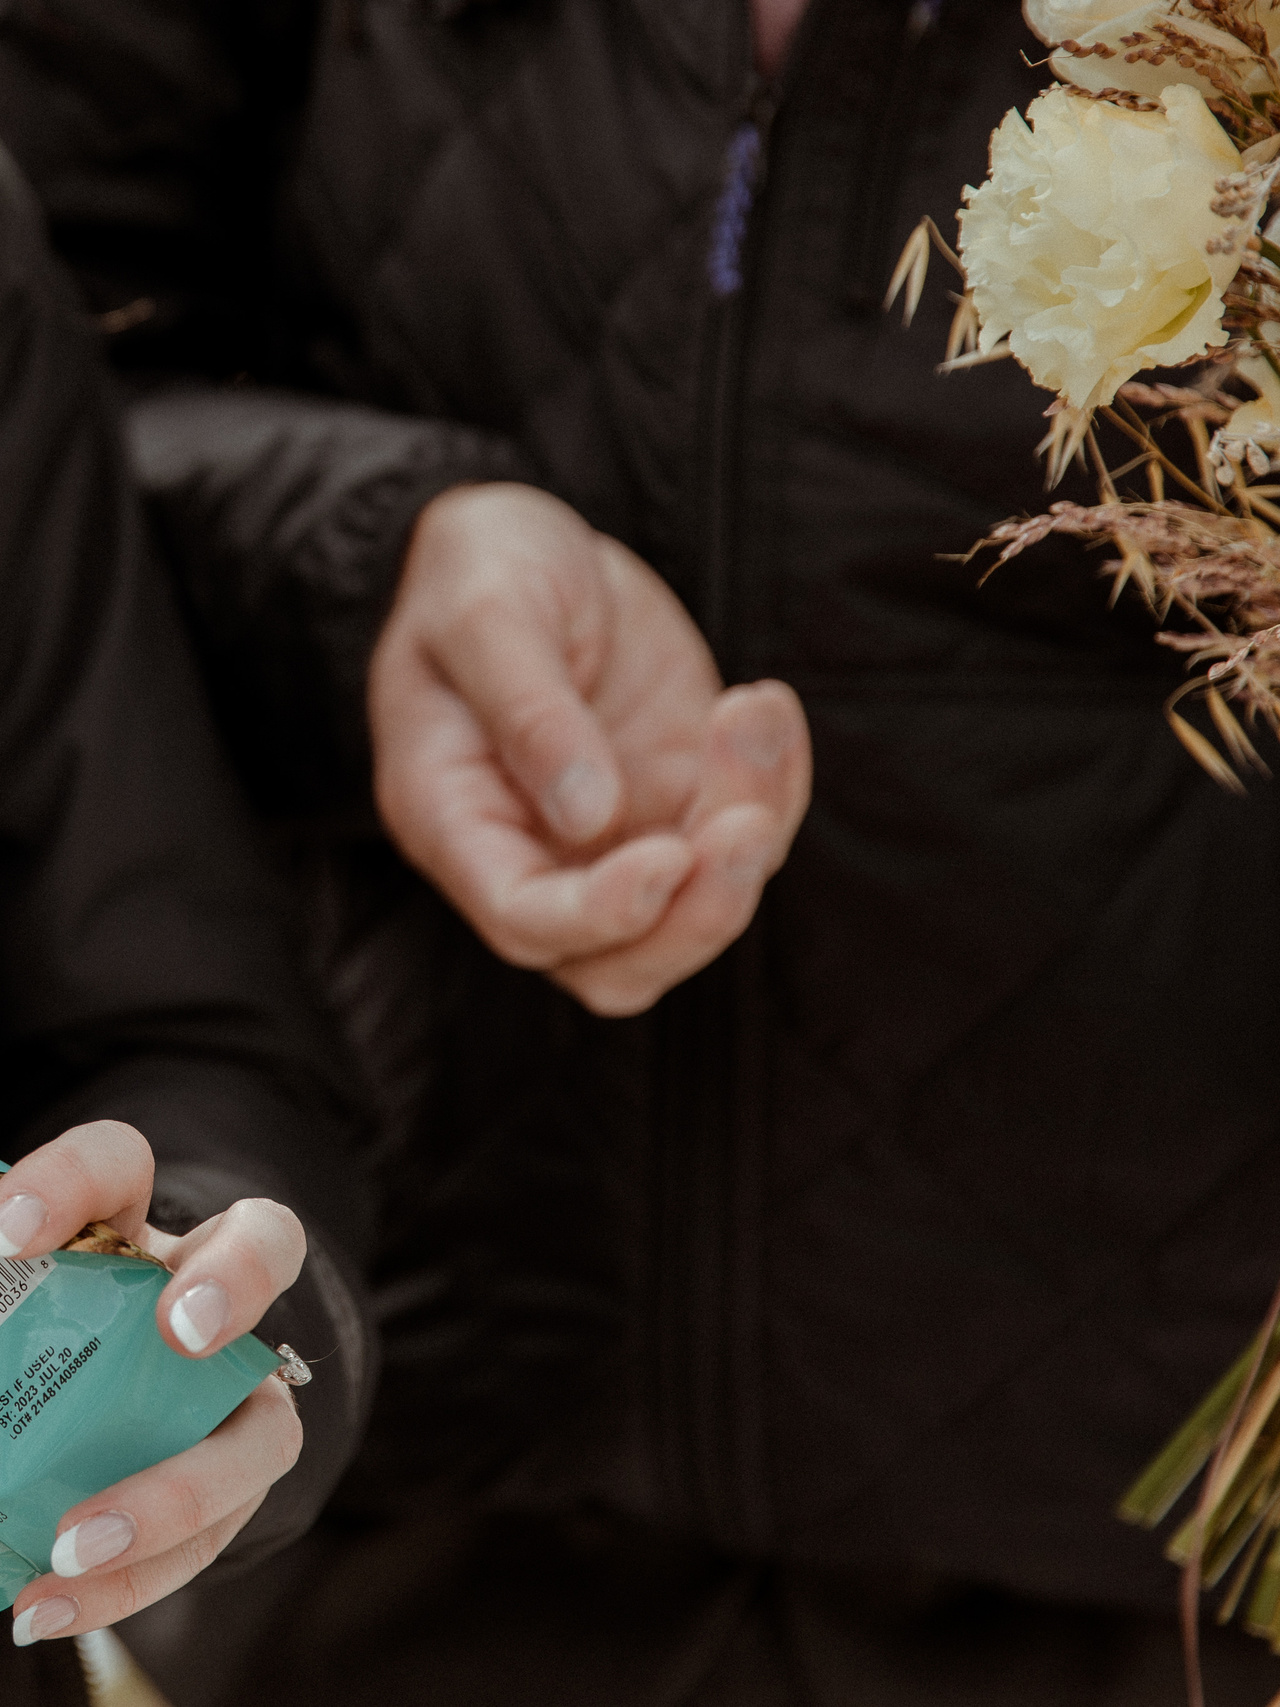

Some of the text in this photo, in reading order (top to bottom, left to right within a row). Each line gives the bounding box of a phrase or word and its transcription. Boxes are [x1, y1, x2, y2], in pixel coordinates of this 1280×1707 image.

[39, 1259, 50, 1270] 8
[12, 1377, 24, 1393] IF
[23, 1345, 56, 1380] USED
[13, 1384, 39, 1413] 2023
[38, 1362, 61, 1388] JUL
[57, 1346, 73, 1365] 20
[29, 1335, 102, 1417] 2148140585801
